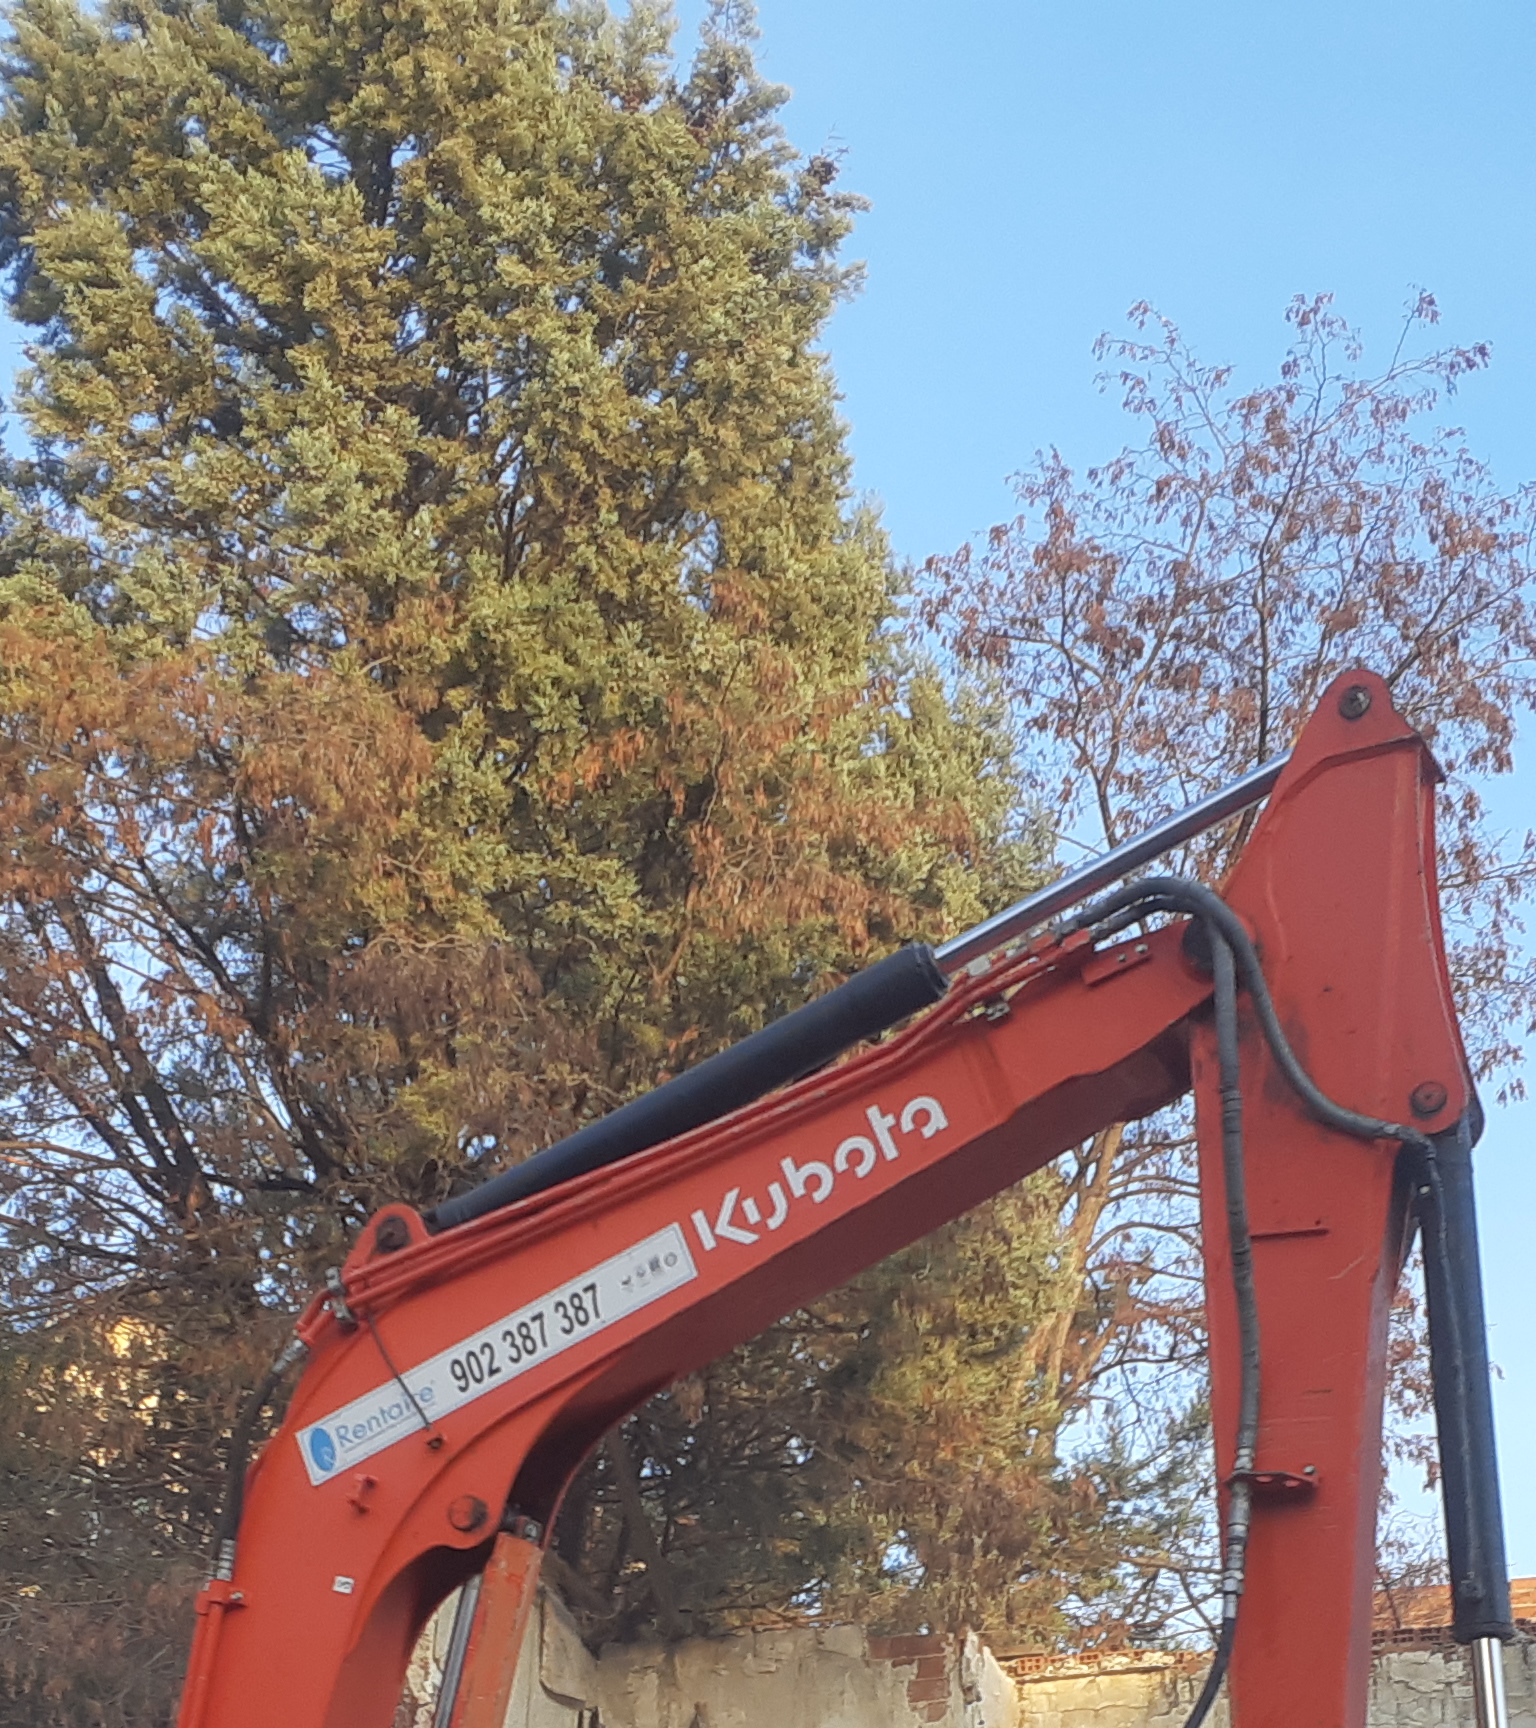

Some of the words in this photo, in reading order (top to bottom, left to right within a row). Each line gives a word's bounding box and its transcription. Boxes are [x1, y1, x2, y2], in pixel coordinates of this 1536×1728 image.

[691, 1096, 948, 1250] Kubota
[449, 1341, 501, 1393] 902
[500, 1313, 551, 1364] 387
[553, 1282, 602, 1335] 387
